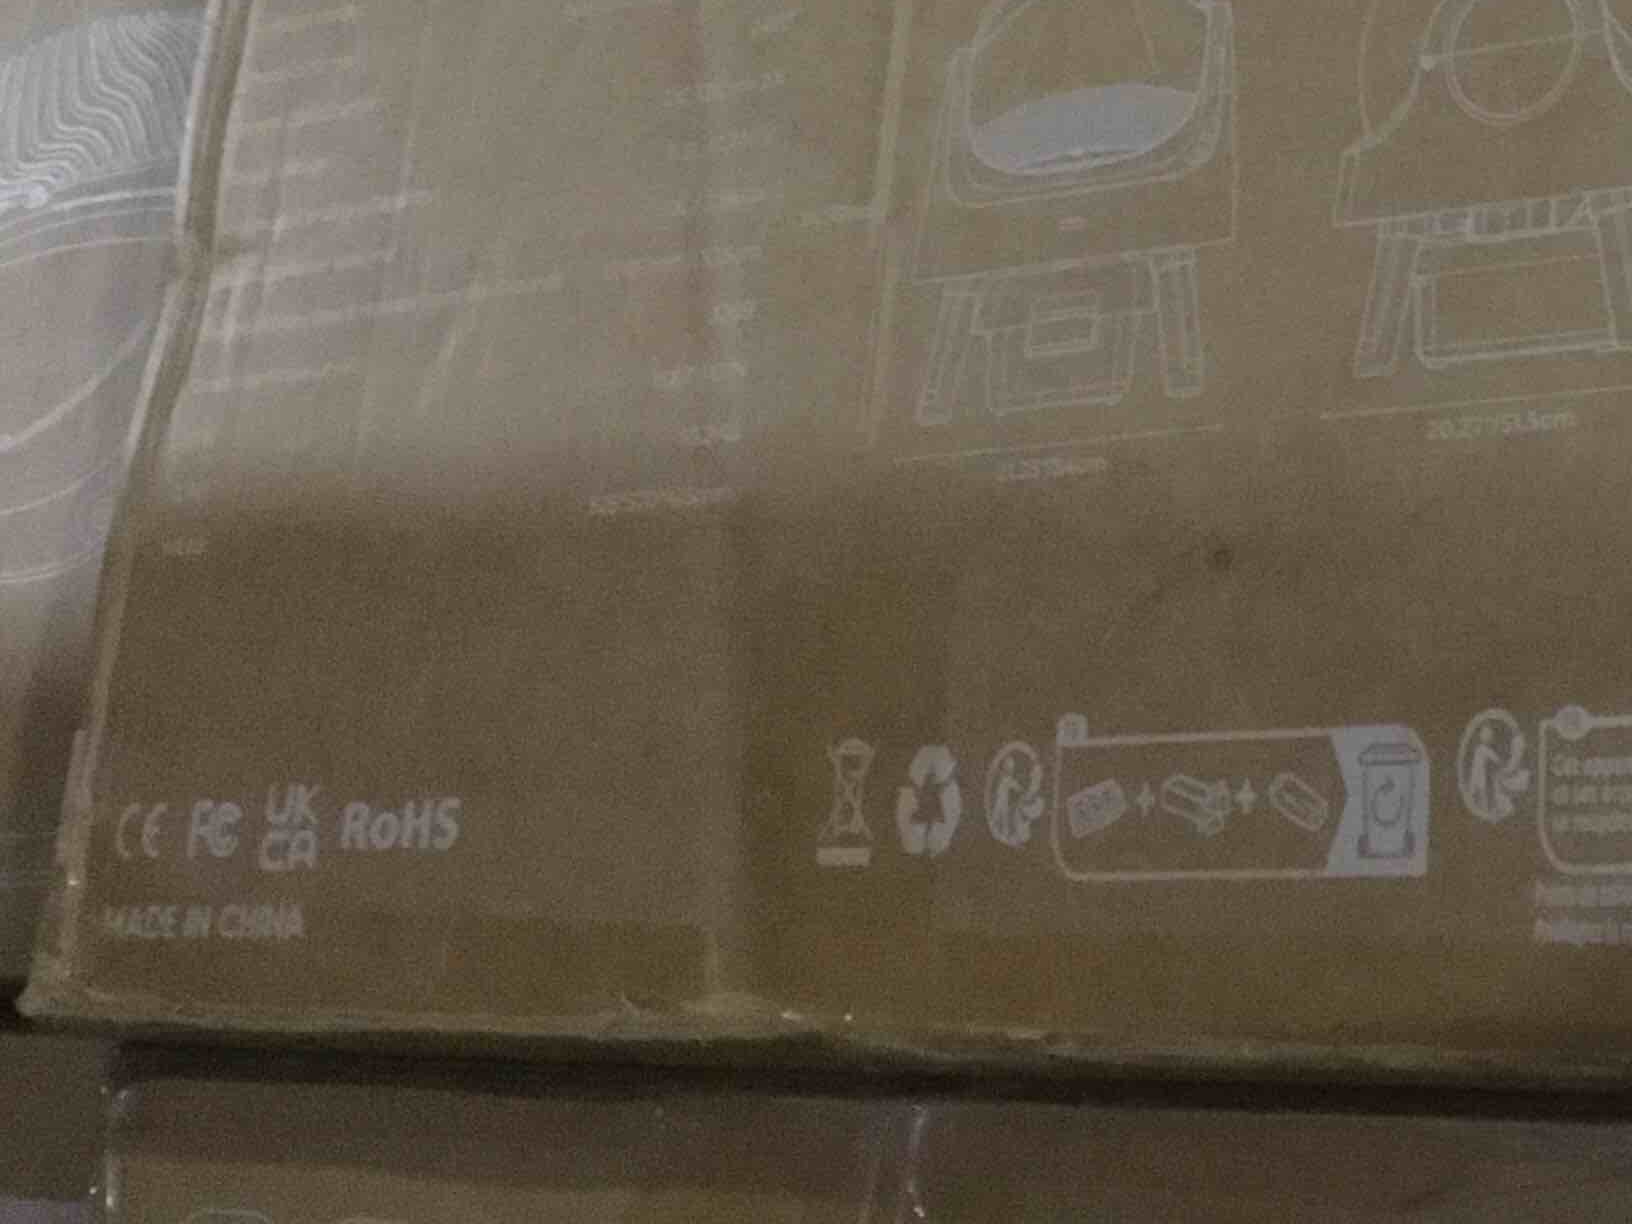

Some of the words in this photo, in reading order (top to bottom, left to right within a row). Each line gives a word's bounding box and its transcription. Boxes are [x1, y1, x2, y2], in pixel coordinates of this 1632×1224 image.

[339, 796, 463, 851] RoHS
[102, 902, 178, 942] MADE
[181, 902, 213, 940] IN
[217, 900, 306, 941] CHINA
